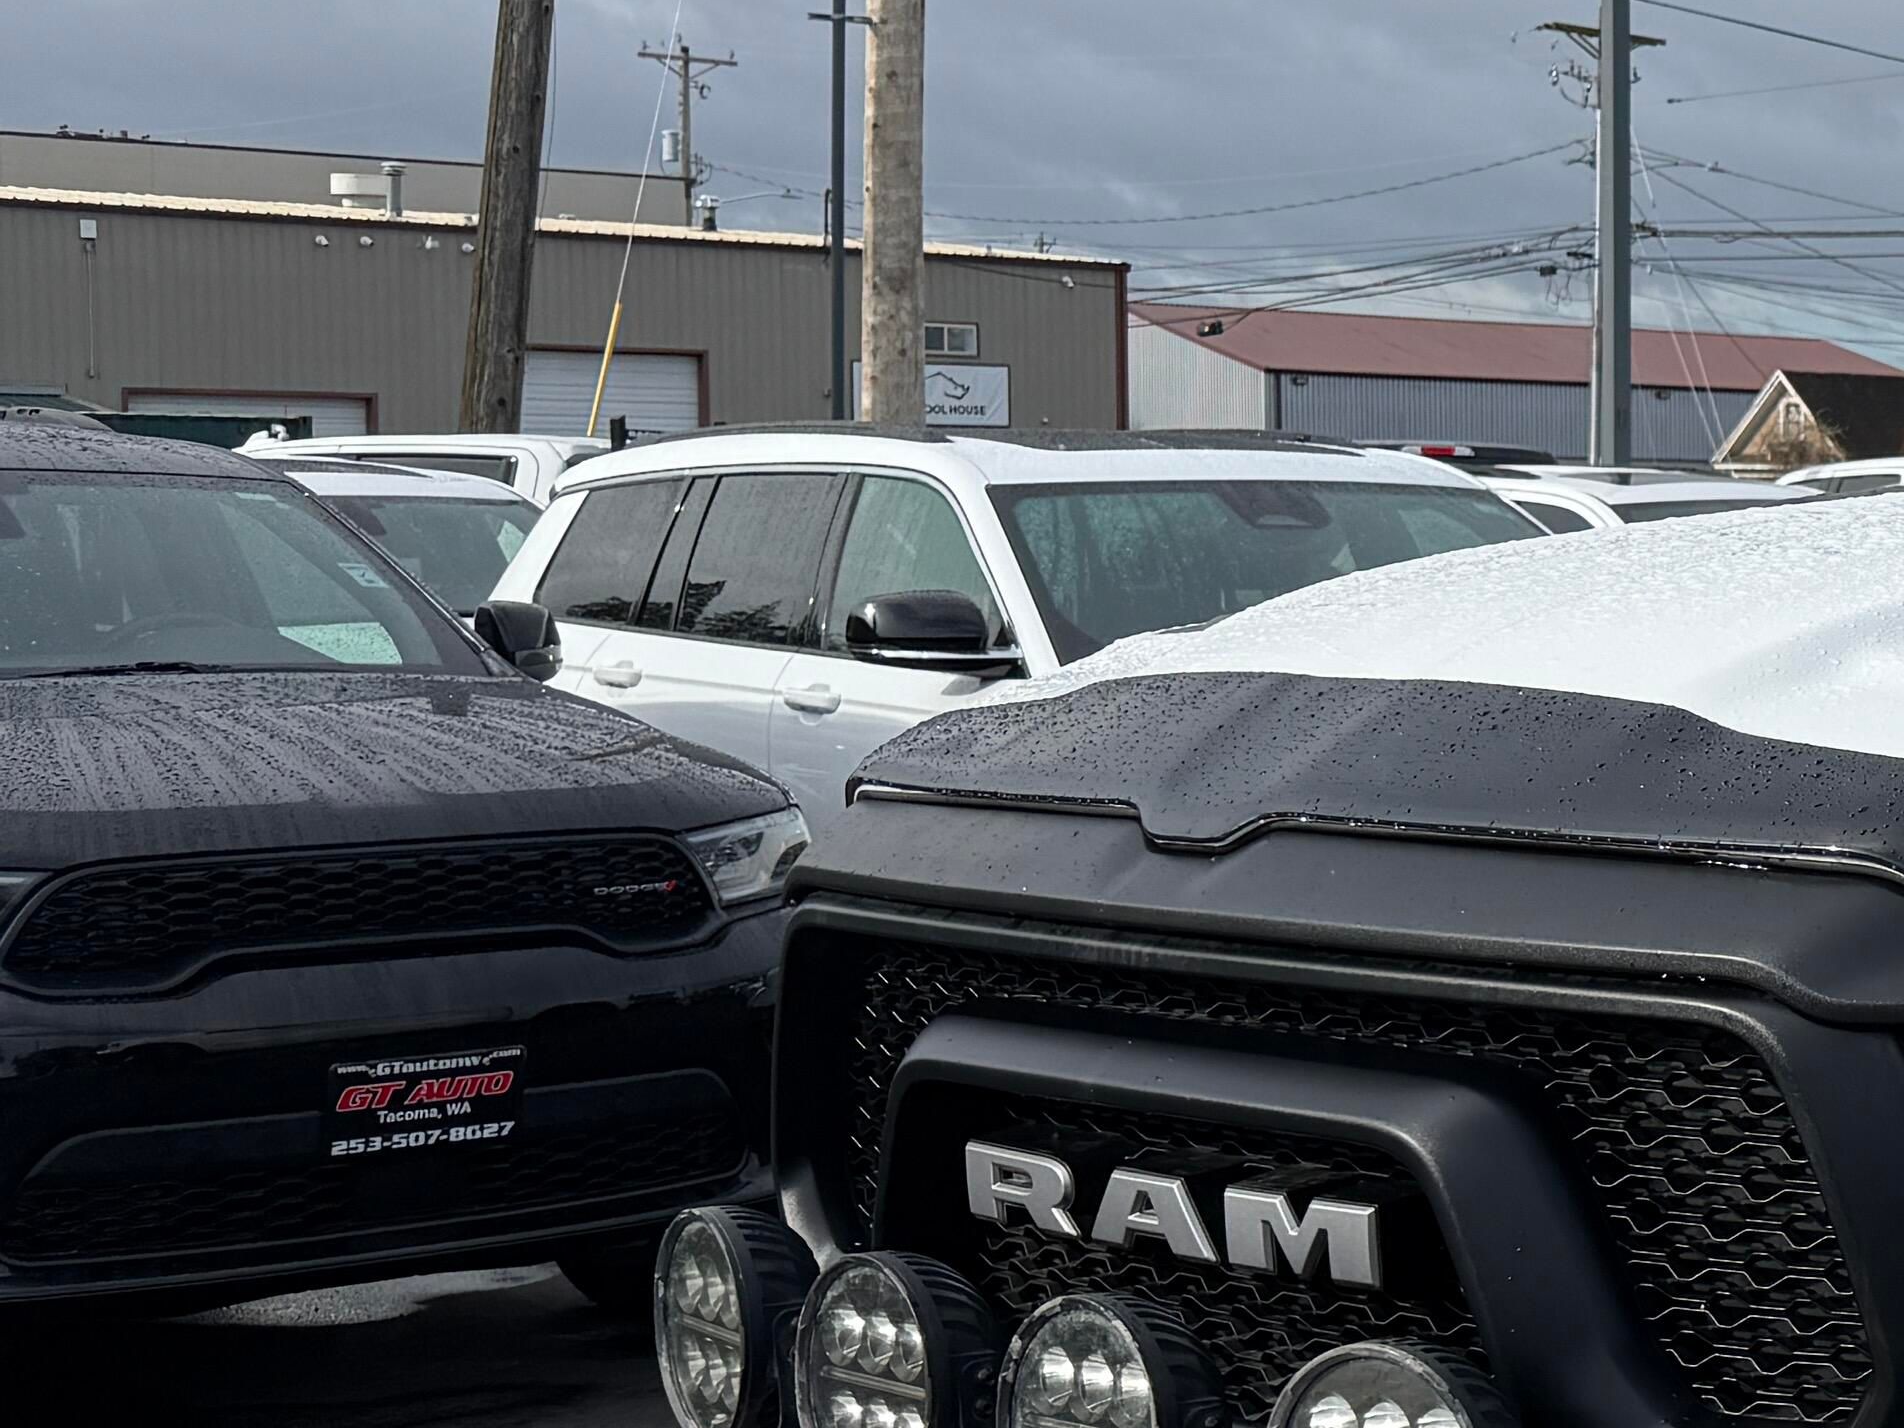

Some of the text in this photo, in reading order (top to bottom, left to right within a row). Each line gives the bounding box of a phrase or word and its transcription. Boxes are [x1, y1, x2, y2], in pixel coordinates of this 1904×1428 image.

[926, 403, 986, 416] OOL HOUSE
[336, 1070, 514, 1113] GT AUTO
[377, 1101, 472, 1124] Tacoma, WA
[965, 1139, 1382, 1290] RAM
